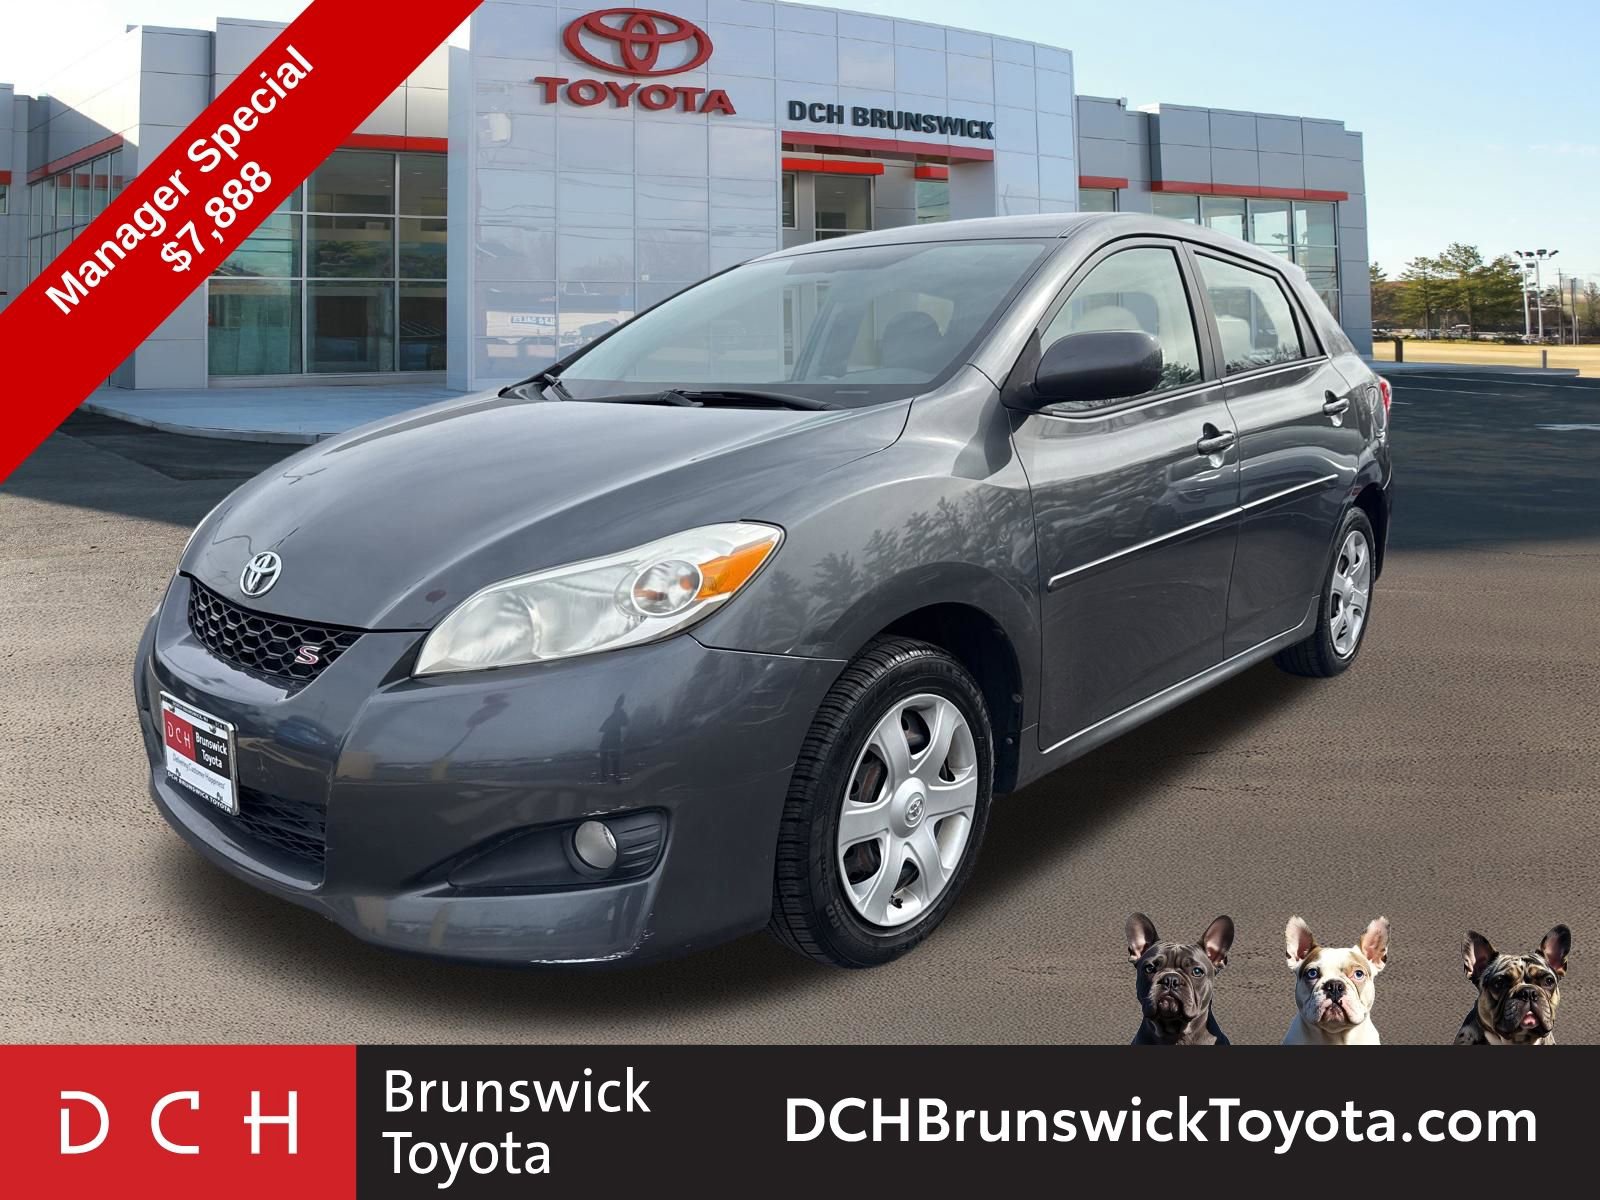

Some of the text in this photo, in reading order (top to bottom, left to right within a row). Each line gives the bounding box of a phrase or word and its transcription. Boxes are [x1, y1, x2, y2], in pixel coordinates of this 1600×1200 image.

[535, 76, 736, 115] TOYOTA
[788, 100, 995, 140] DCH BRUNSWICK
[295, 645, 320, 665] S
[167, 720, 191, 749] DCH
[195, 731, 228, 756] Brunswick
[201, 748, 223, 769] Toyota
[178, 778, 209, 801] BRUNSWICK
[209, 796, 231, 814] TOYOTA
